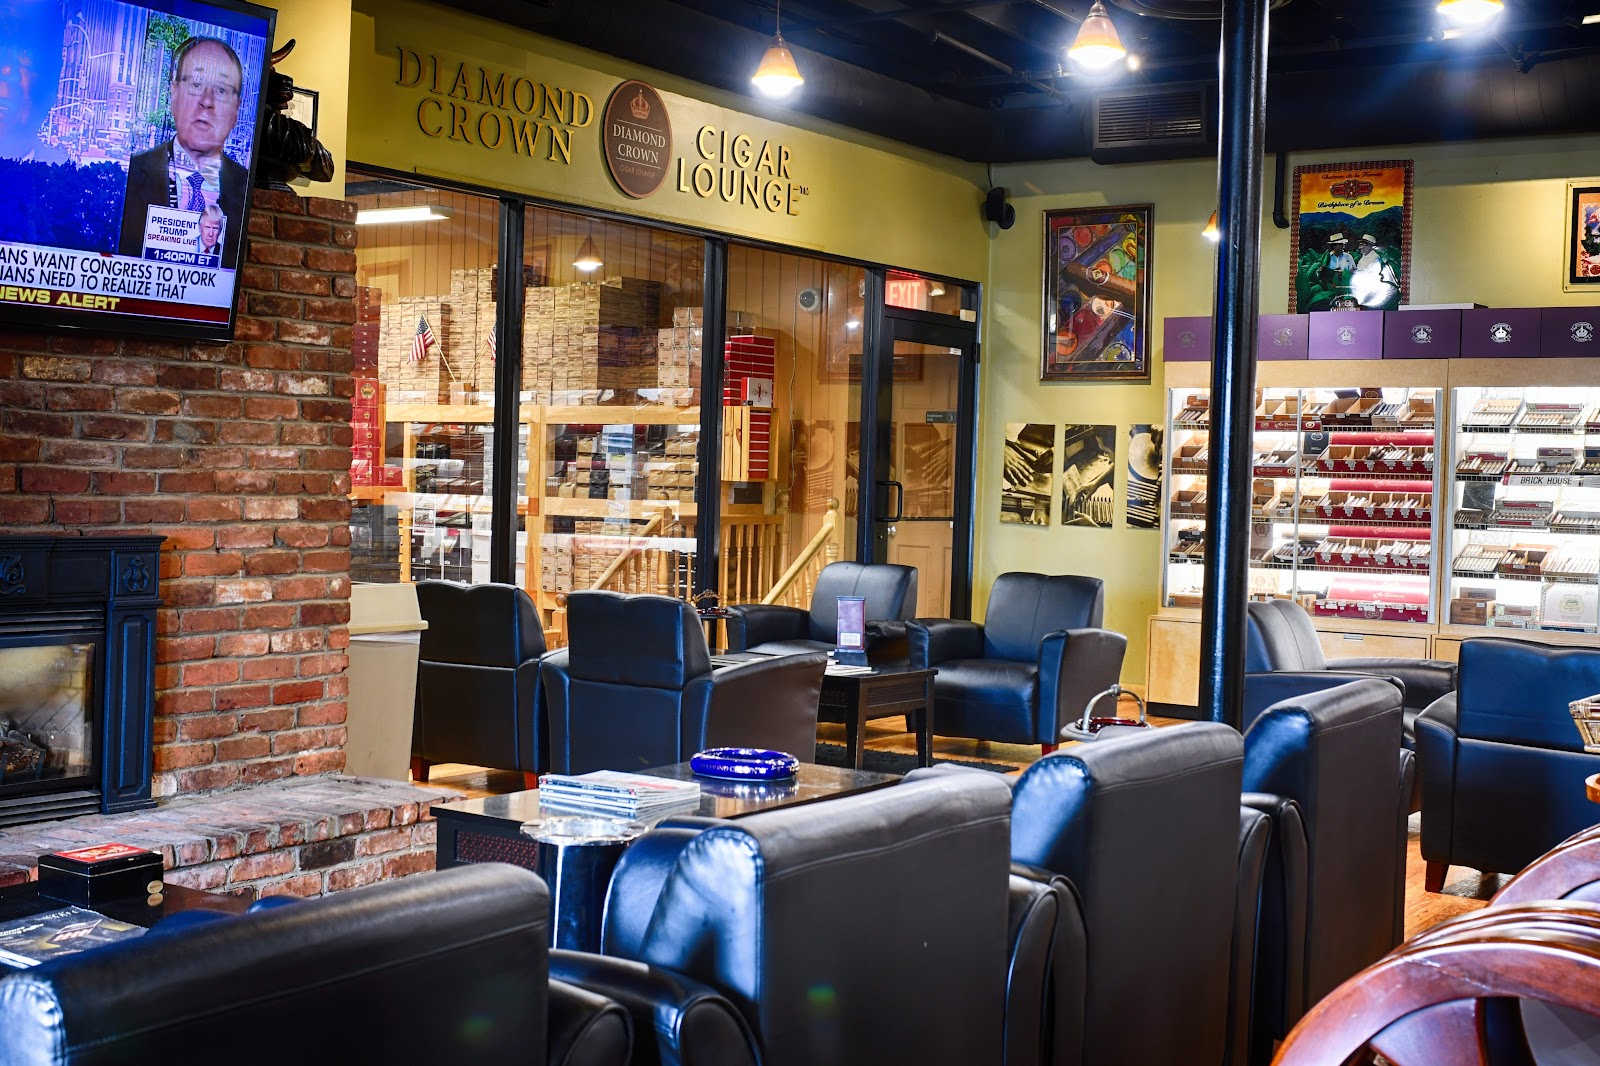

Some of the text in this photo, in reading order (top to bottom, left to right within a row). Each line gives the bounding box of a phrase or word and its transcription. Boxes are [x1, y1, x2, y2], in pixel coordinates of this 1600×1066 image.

[396, 46, 594, 128] DIAMOND
[417, 97, 574, 165] CROWN
[613, 124, 666, 148] DIAMOND
[618, 143, 659, 164] CROWN
[695, 125, 791, 179] CIGAR
[619, 165, 635, 175] CIGAR
[151, 216, 198, 230] PRESIDENT
[159, 226, 188, 237] TRUMP
[147, 233, 197, 246] SPEAKING LIVE
[154, 249, 212, 266] 1:40PM ET
[33, 251, 77, 271] WANT
[80, 257, 153, 280] CONGRESS
[156, 266, 173, 282] TO
[177, 268, 217, 287] WORK
[39, 269, 76, 288] NEED
[80, 274, 98, 290] TO
[102, 276, 152, 296] REALIZE
[155, 282, 187, 300] THAT
[889, 281, 921, 309] EXIT
[56, 292, 120, 310] ALERT
[1520, 476, 1572, 485] BRICK HOUSE
